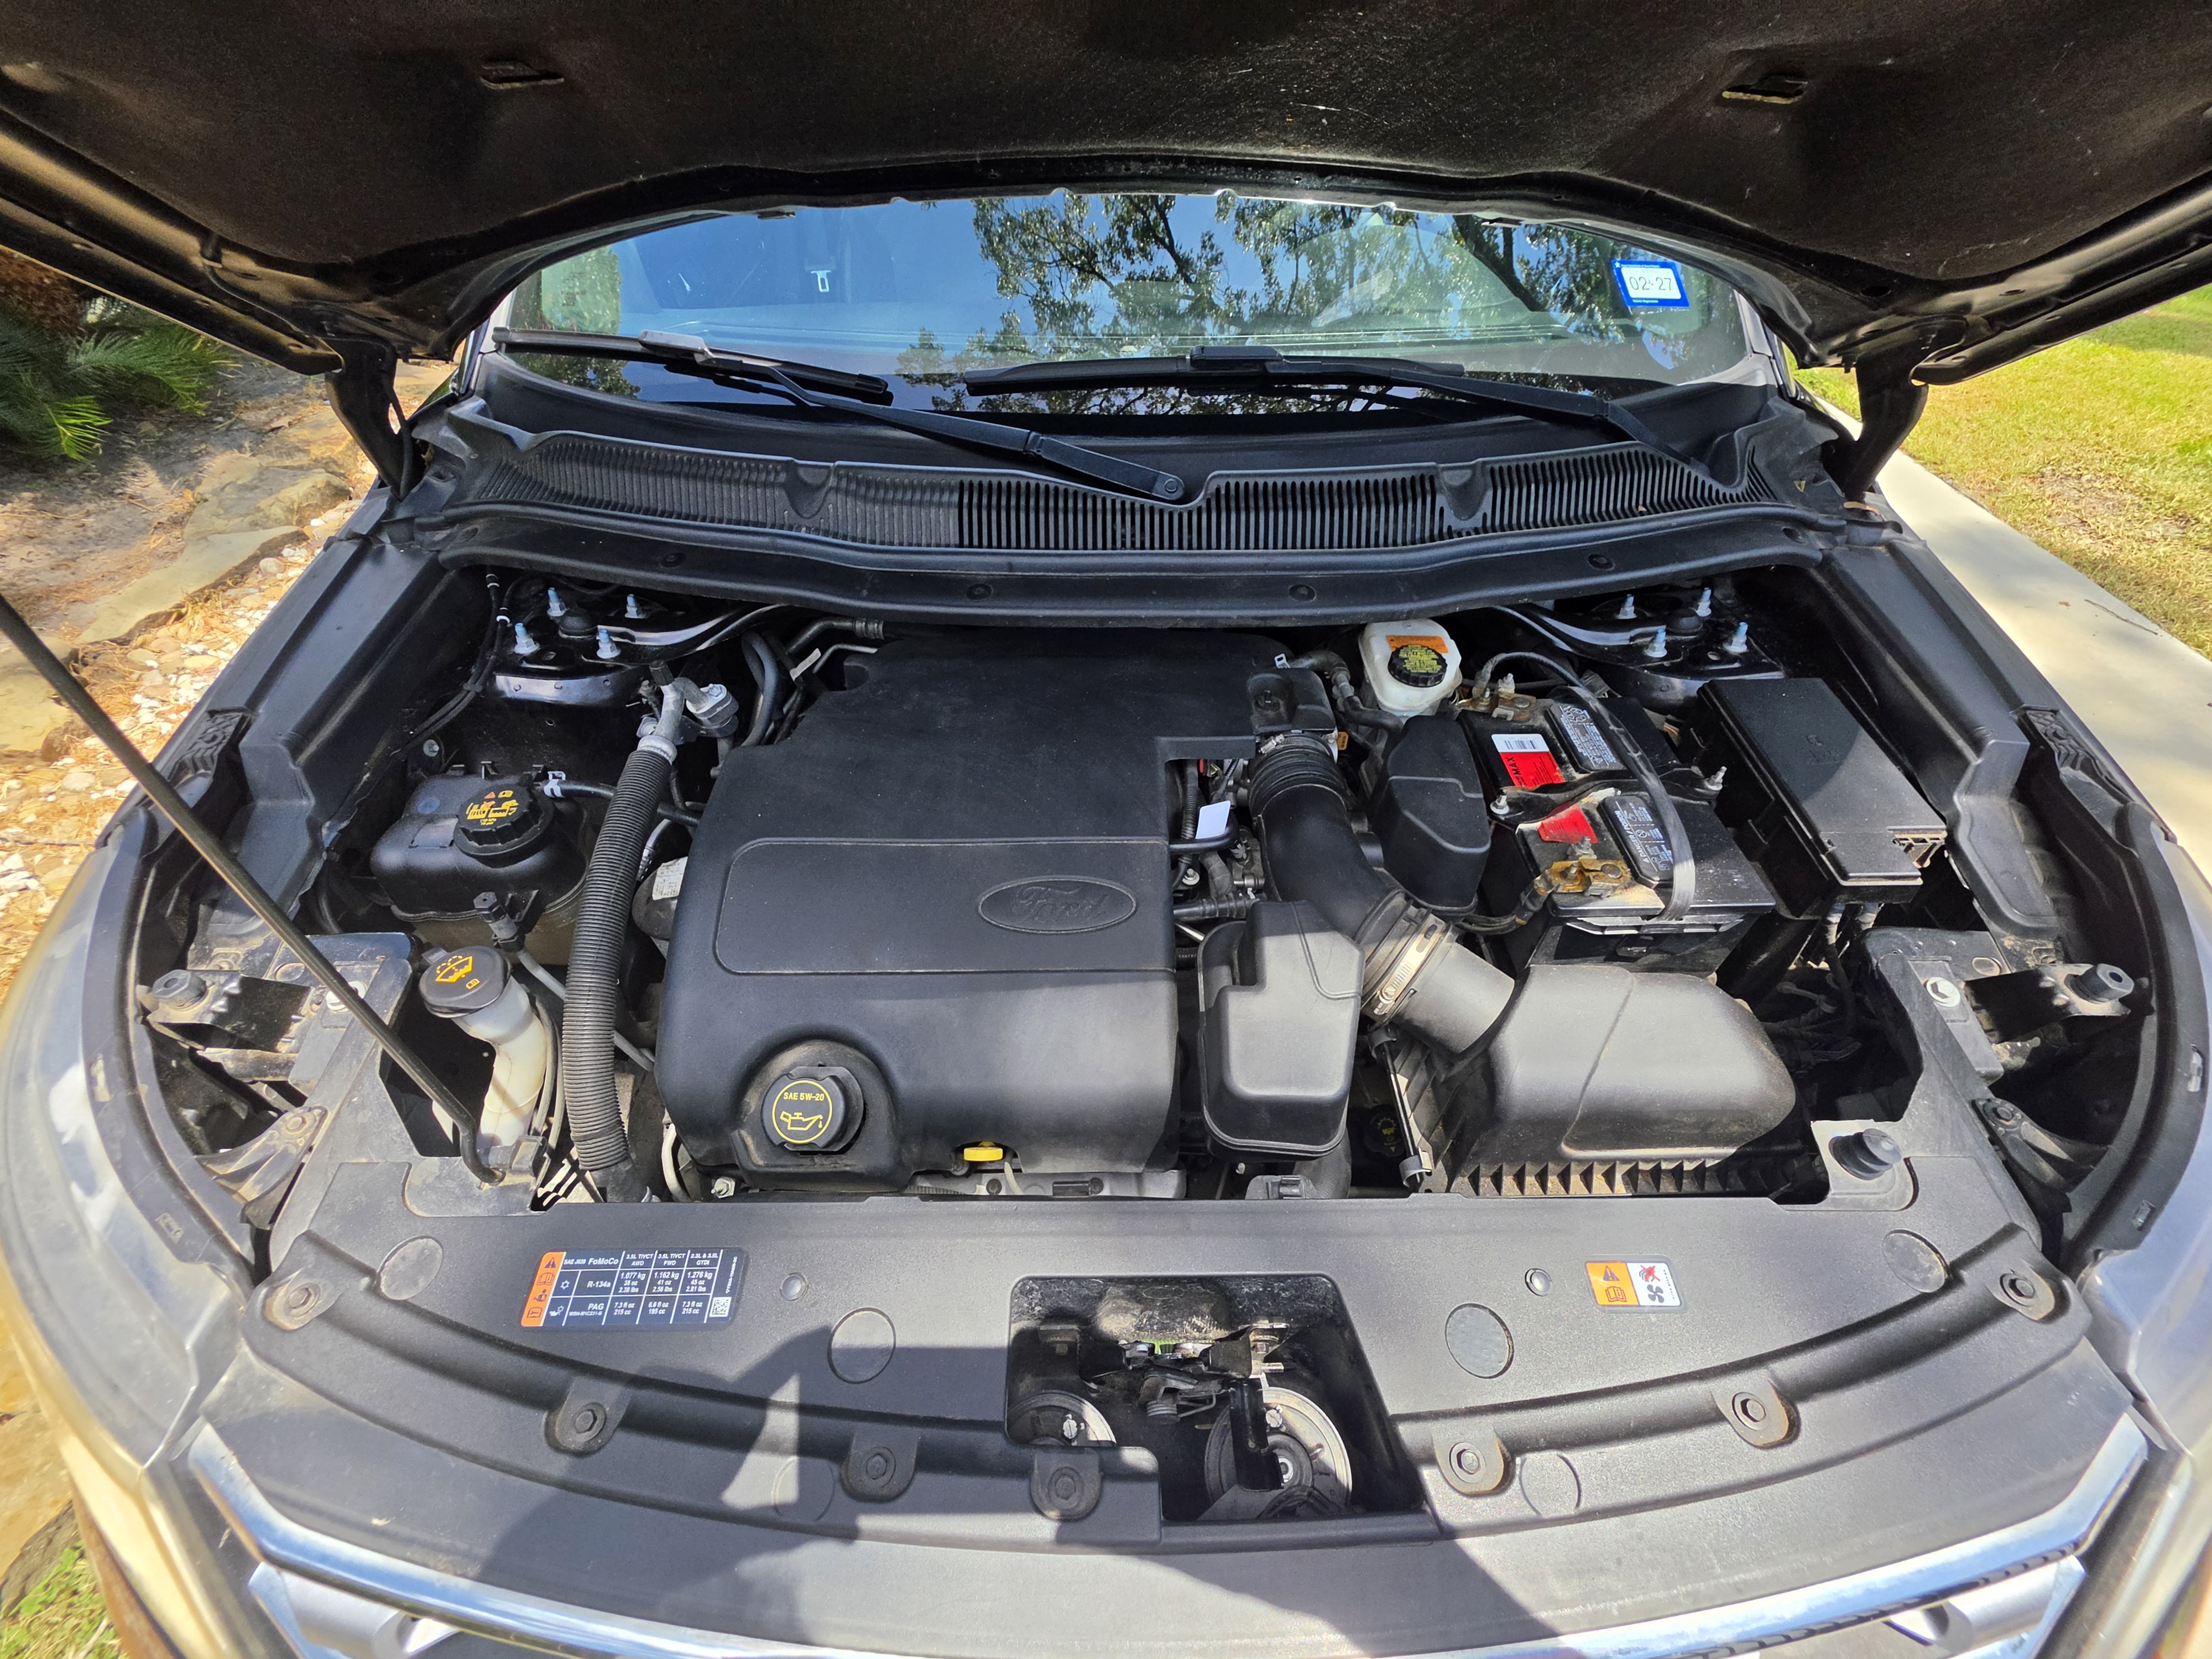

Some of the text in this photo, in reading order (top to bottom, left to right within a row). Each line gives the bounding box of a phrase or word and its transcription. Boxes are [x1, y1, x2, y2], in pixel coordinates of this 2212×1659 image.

[1629, 276, 1671, 290] 02 27
[1505, 756, 1522, 775] MAX
[1614, 810, 1630, 830] POISON
[1629, 834, 1646, 857] DANGER
[1006, 885, 1109, 924] Ford
[783, 1092, 825, 1101] SAE 5W-20
[638, 1272, 646, 1280] kg
[671, 1271, 680, 1280] kg
[704, 1271, 713, 1280] kg
